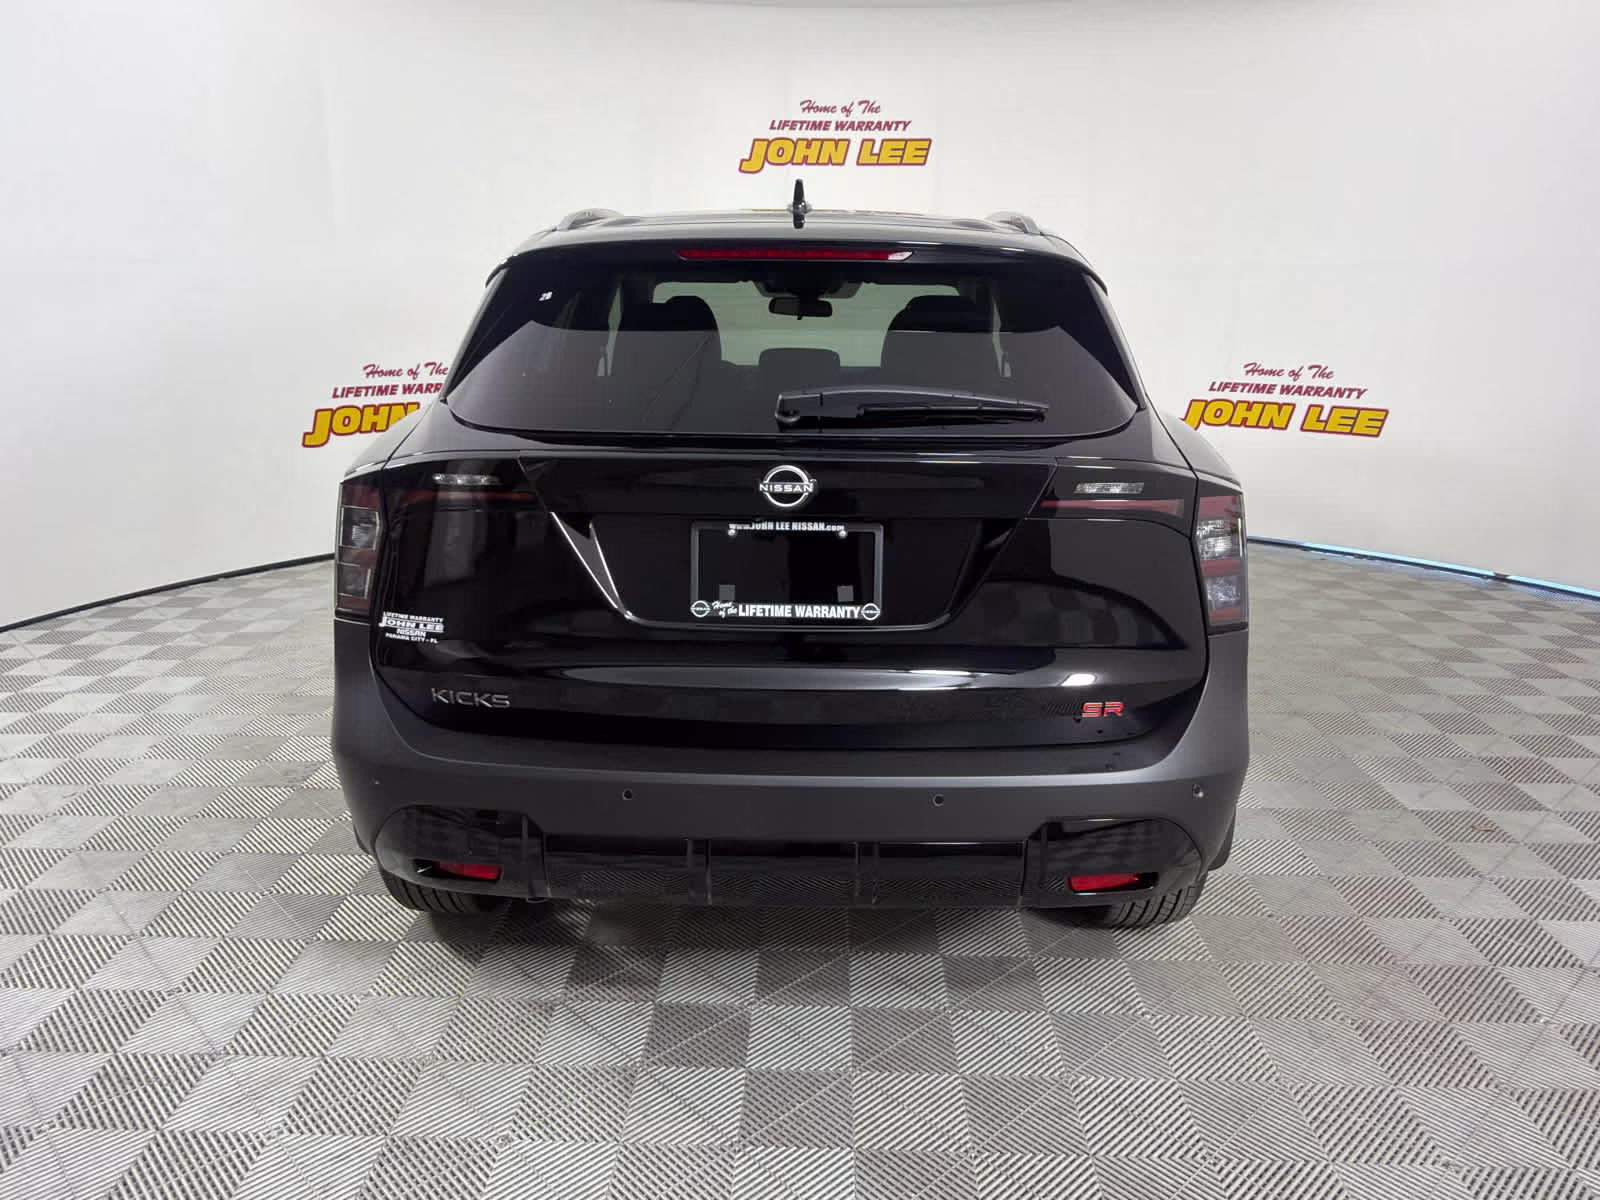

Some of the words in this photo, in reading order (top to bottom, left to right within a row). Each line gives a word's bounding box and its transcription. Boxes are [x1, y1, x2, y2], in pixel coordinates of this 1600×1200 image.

[800, 99, 837, 114] Home
[840, 102, 853, 117] of
[858, 100, 881, 114] The
[769, 120, 832, 131] LIFETIME
[834, 120, 912, 132] WARRANTY
[738, 137, 850, 174] JOHN
[856, 138, 932, 166] LEE
[363, 364, 403, 379] Home
[407, 364, 420, 380] of
[424, 362, 449, 376] The
[1243, 362, 1285, 378] Home
[1287, 366, 1304, 381] of
[1308, 364, 1335, 380] The
[332, 384, 399, 399] LIFETIME
[402, 382, 443, 395] WARR
[1208, 381, 1277, 395] LIFETIME
[1279, 384, 1368, 400] WARRANTY
[1181, 399, 1296, 431] JOHN
[1299, 404, 1390, 438] LEE
[759, 483, 814, 493] NISSAN
[775, 521, 791, 531] LEE
[792, 521, 845, 532] NISSAN.com
[711, 600, 733, 610] Home
[738, 603, 792, 618] LIFETIME
[794, 606, 861, 620] WARRANTY
[379, 616, 417, 629] JOHN
[396, 628, 427, 637] NISSAN
[431, 687, 511, 708] KICKS
[1081, 701, 1125, 718] SR
